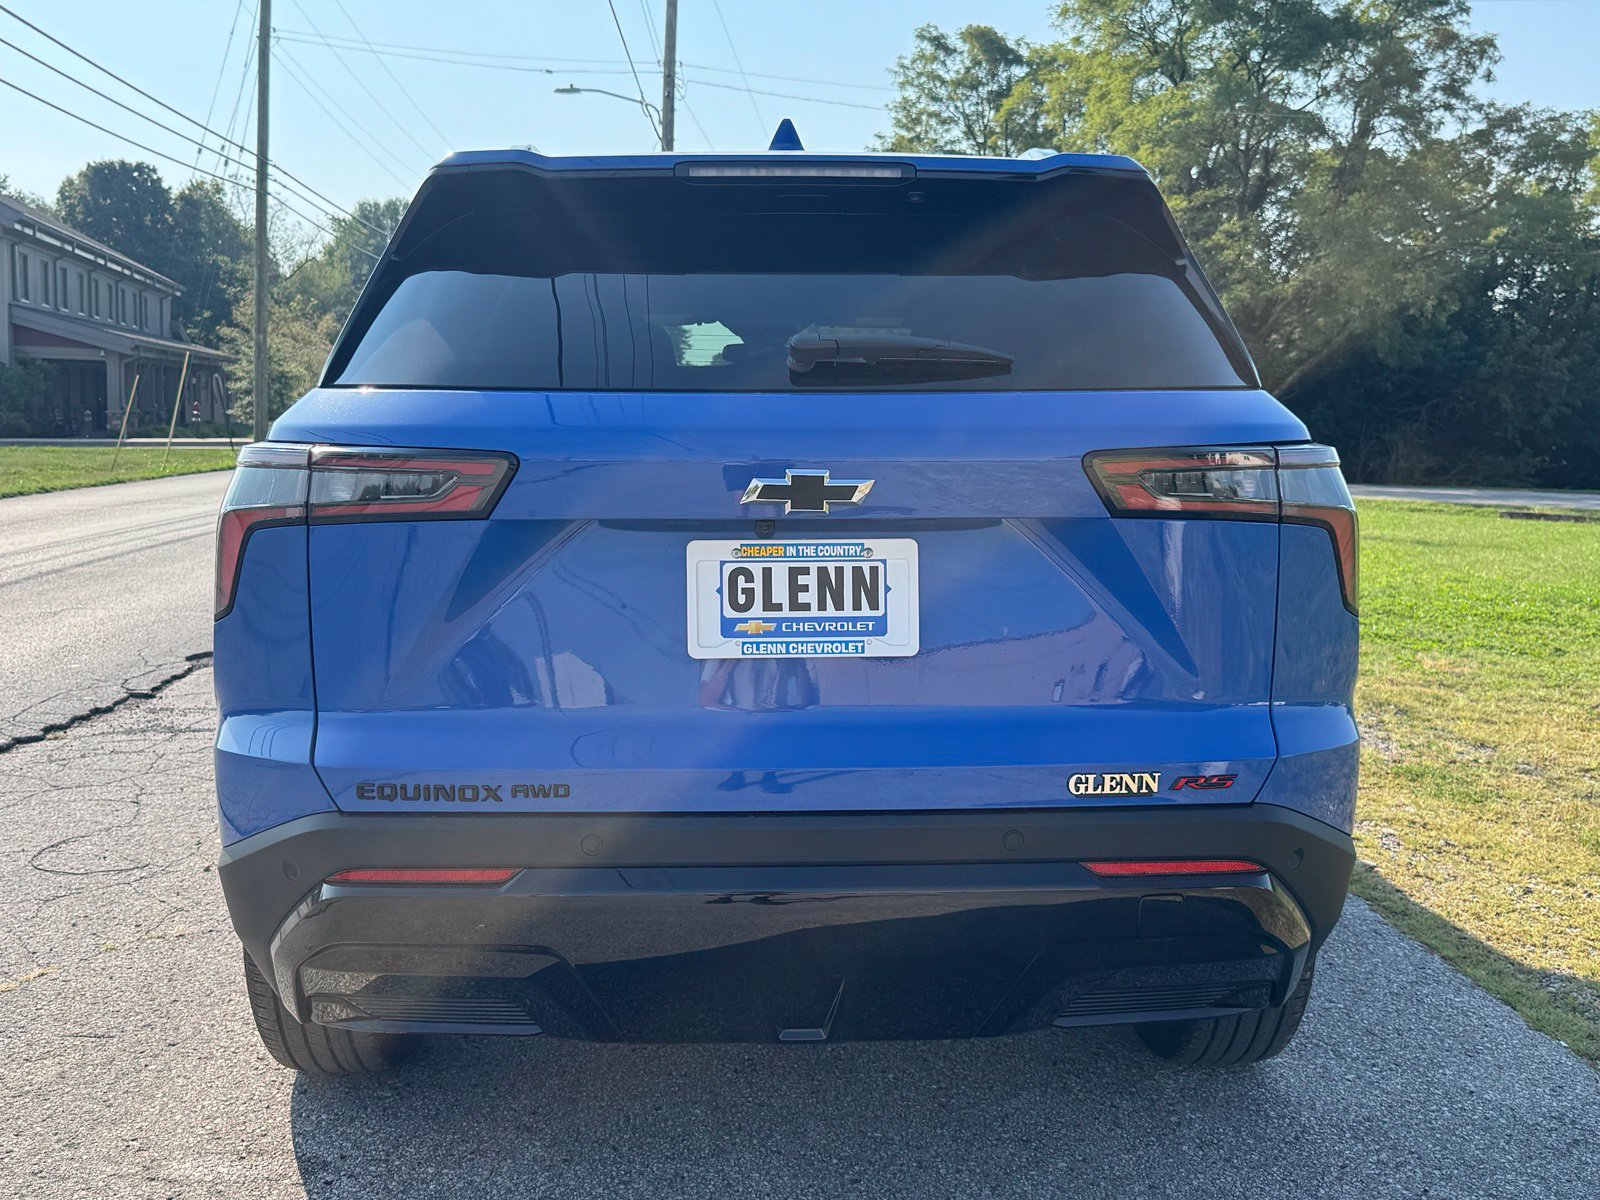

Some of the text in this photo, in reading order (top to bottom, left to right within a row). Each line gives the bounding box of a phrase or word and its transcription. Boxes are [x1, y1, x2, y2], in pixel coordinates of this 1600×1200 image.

[741, 546, 784, 557] CHEAPER
[786, 546, 797, 556] IN
[798, 546, 816, 556] THE
[727, 565, 880, 613] GLENN
[781, 622, 875, 632] CHEVROLET
[743, 642, 864, 654] GLENN CHEVROLET
[1067, 772, 1161, 796] GLENN
[1169, 774, 1238, 790] RS
[355, 783, 570, 802] EQUINOX AWD
